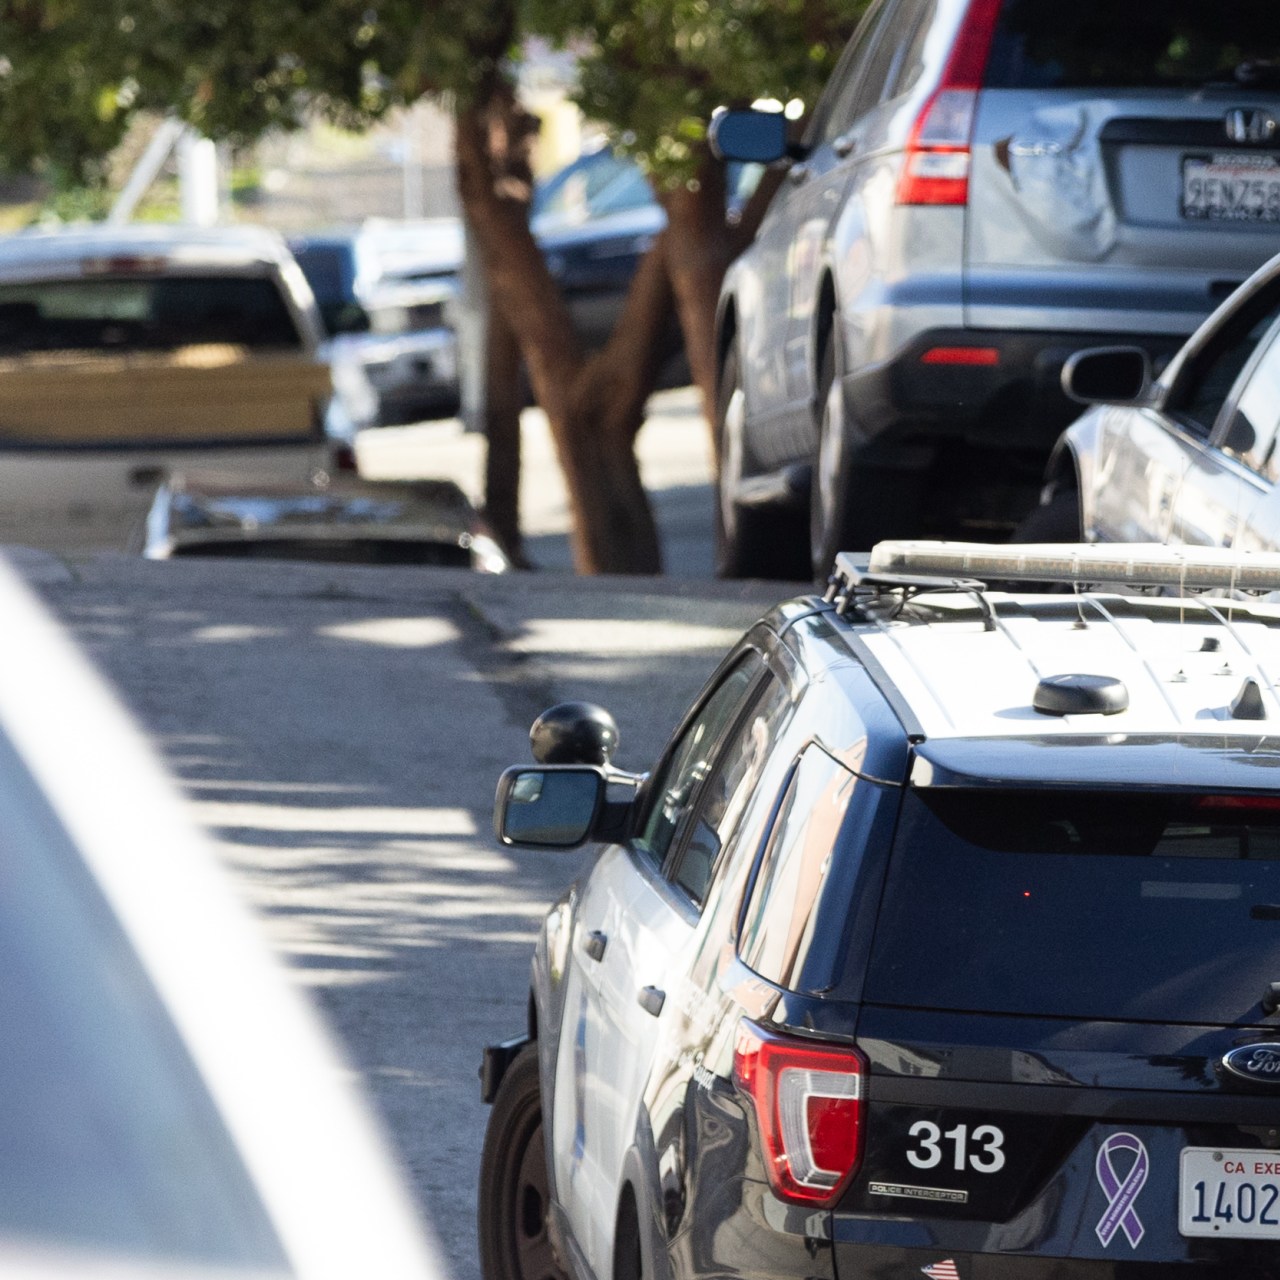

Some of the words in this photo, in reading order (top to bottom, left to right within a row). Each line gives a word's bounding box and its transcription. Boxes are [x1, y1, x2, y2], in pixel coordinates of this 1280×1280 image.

[906, 1120, 1006, 1174] 313
[1223, 1162, 1246, 1174] CA
[871, 1185, 902, 1194] POLICE
[903, 1188, 964, 1200] INTERCEPTOR
